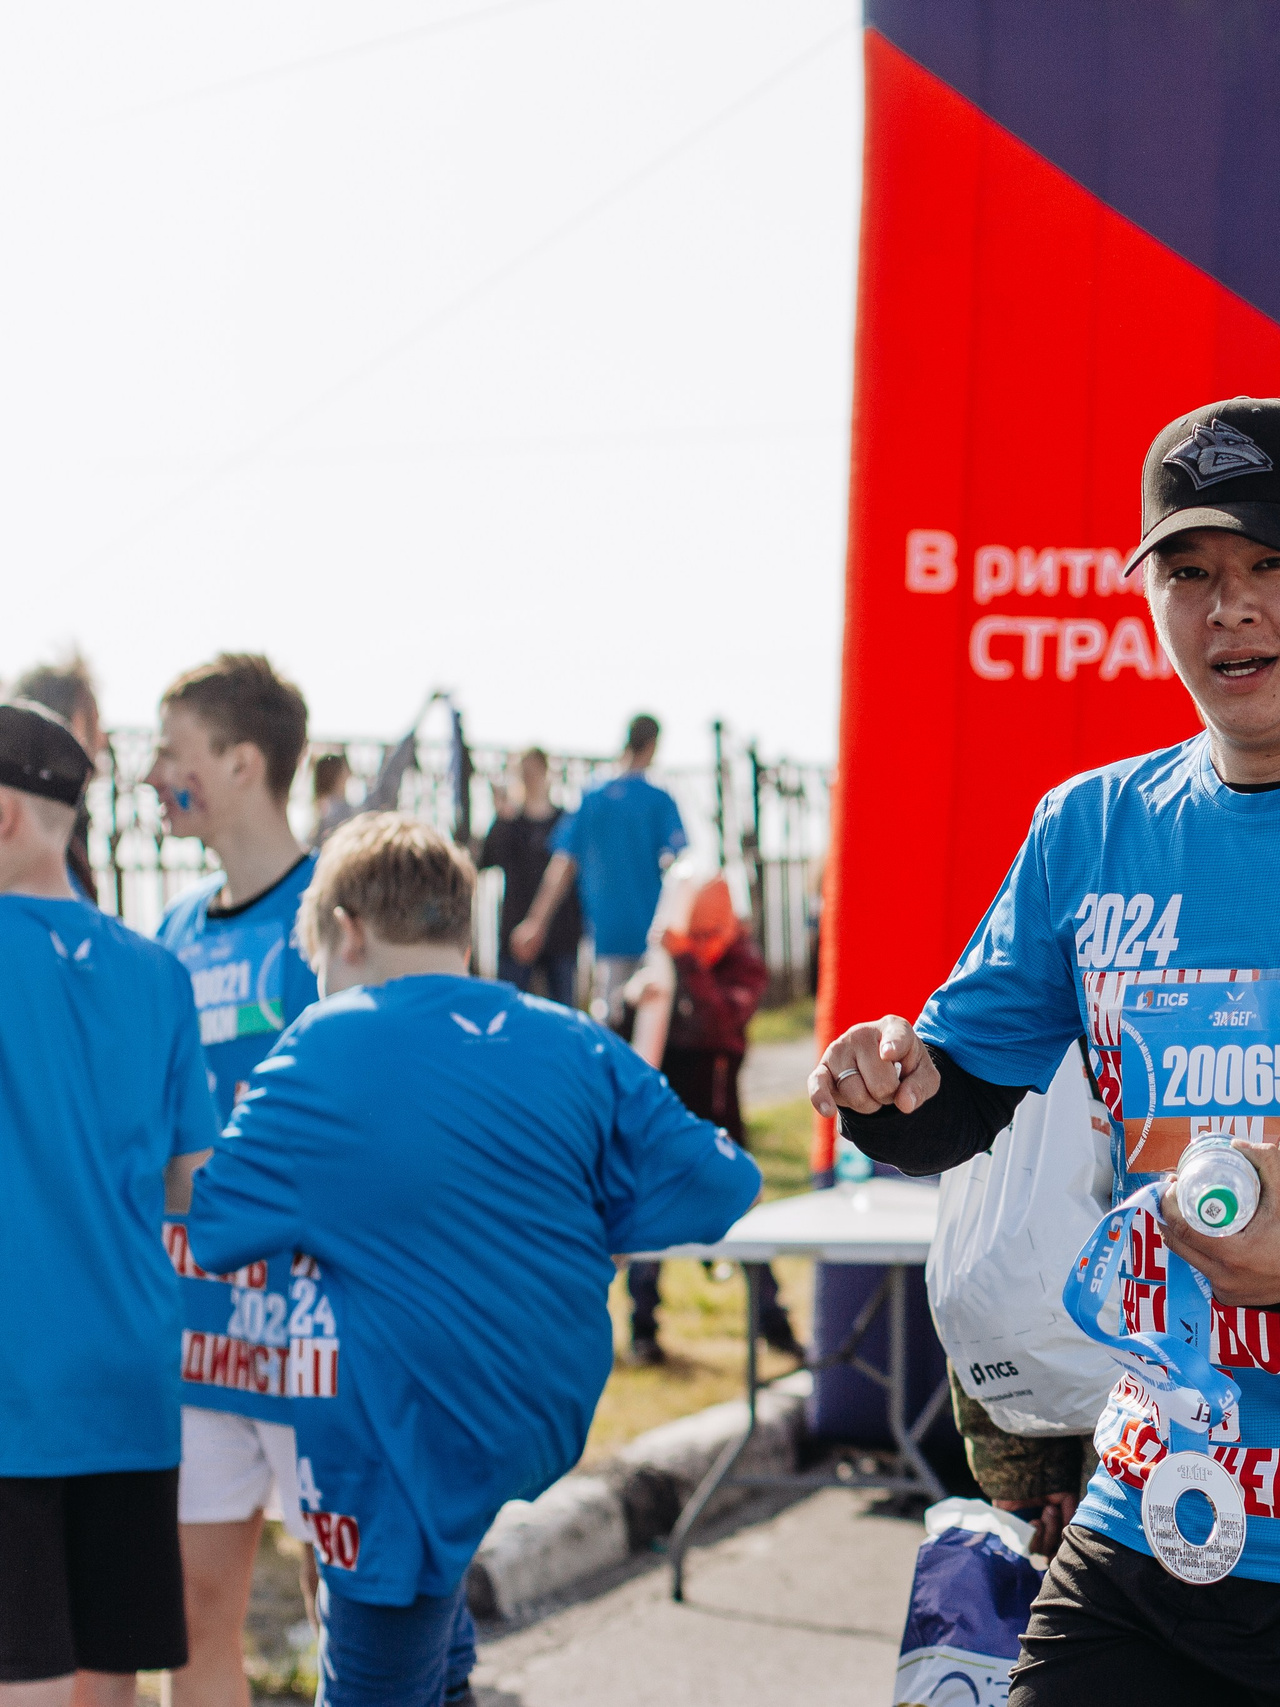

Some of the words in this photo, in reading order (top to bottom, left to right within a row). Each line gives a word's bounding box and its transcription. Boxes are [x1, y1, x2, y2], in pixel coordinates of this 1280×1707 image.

[906, 529, 958, 593] В
[1075, 893, 1183, 968] 2024
[1157, 993, 1189, 1007] ПСБ
[1090, 1244, 1113, 1294] ПСБ
[985, 1361, 1019, 1380] ПСБ
